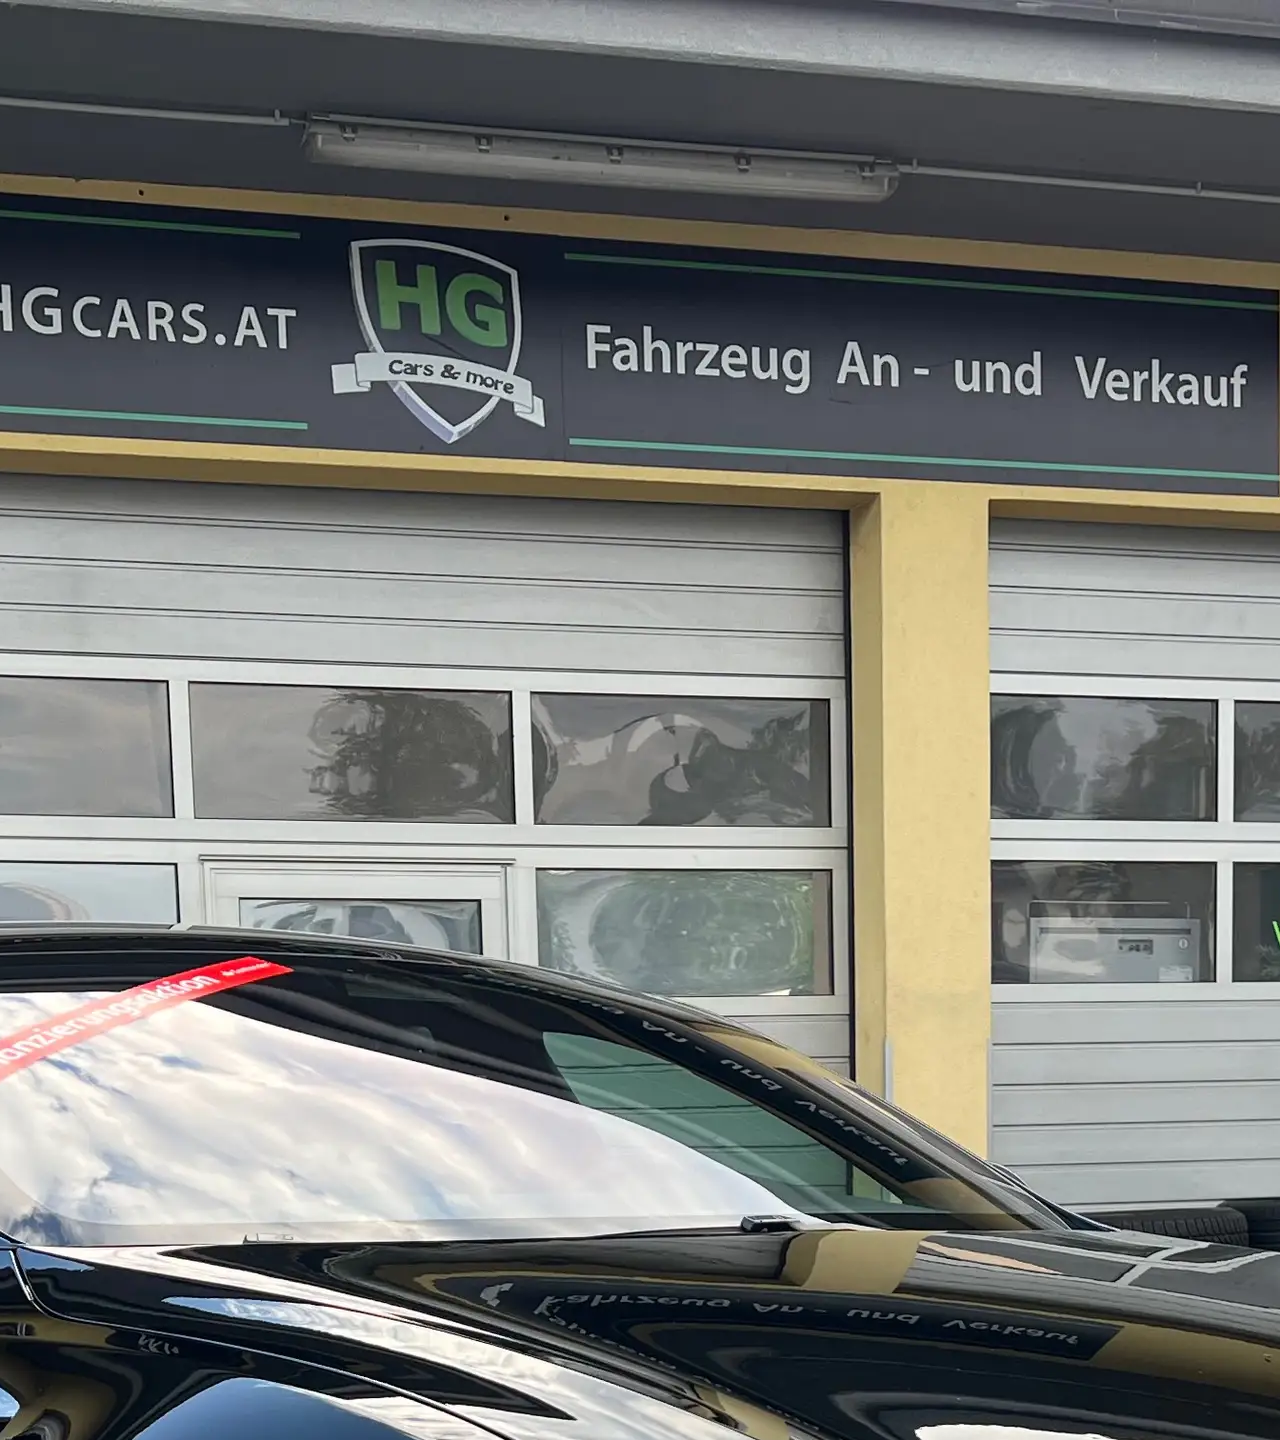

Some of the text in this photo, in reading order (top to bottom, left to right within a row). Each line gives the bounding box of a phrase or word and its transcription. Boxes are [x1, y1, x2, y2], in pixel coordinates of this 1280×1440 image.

[375, 259, 508, 348] HG
[388, 359, 515, 395] Cars & more
[585, 324, 811, 395] Fahrzeug
[953, 350, 1043, 396] und
[1074, 355, 1249, 408] Verkauf
